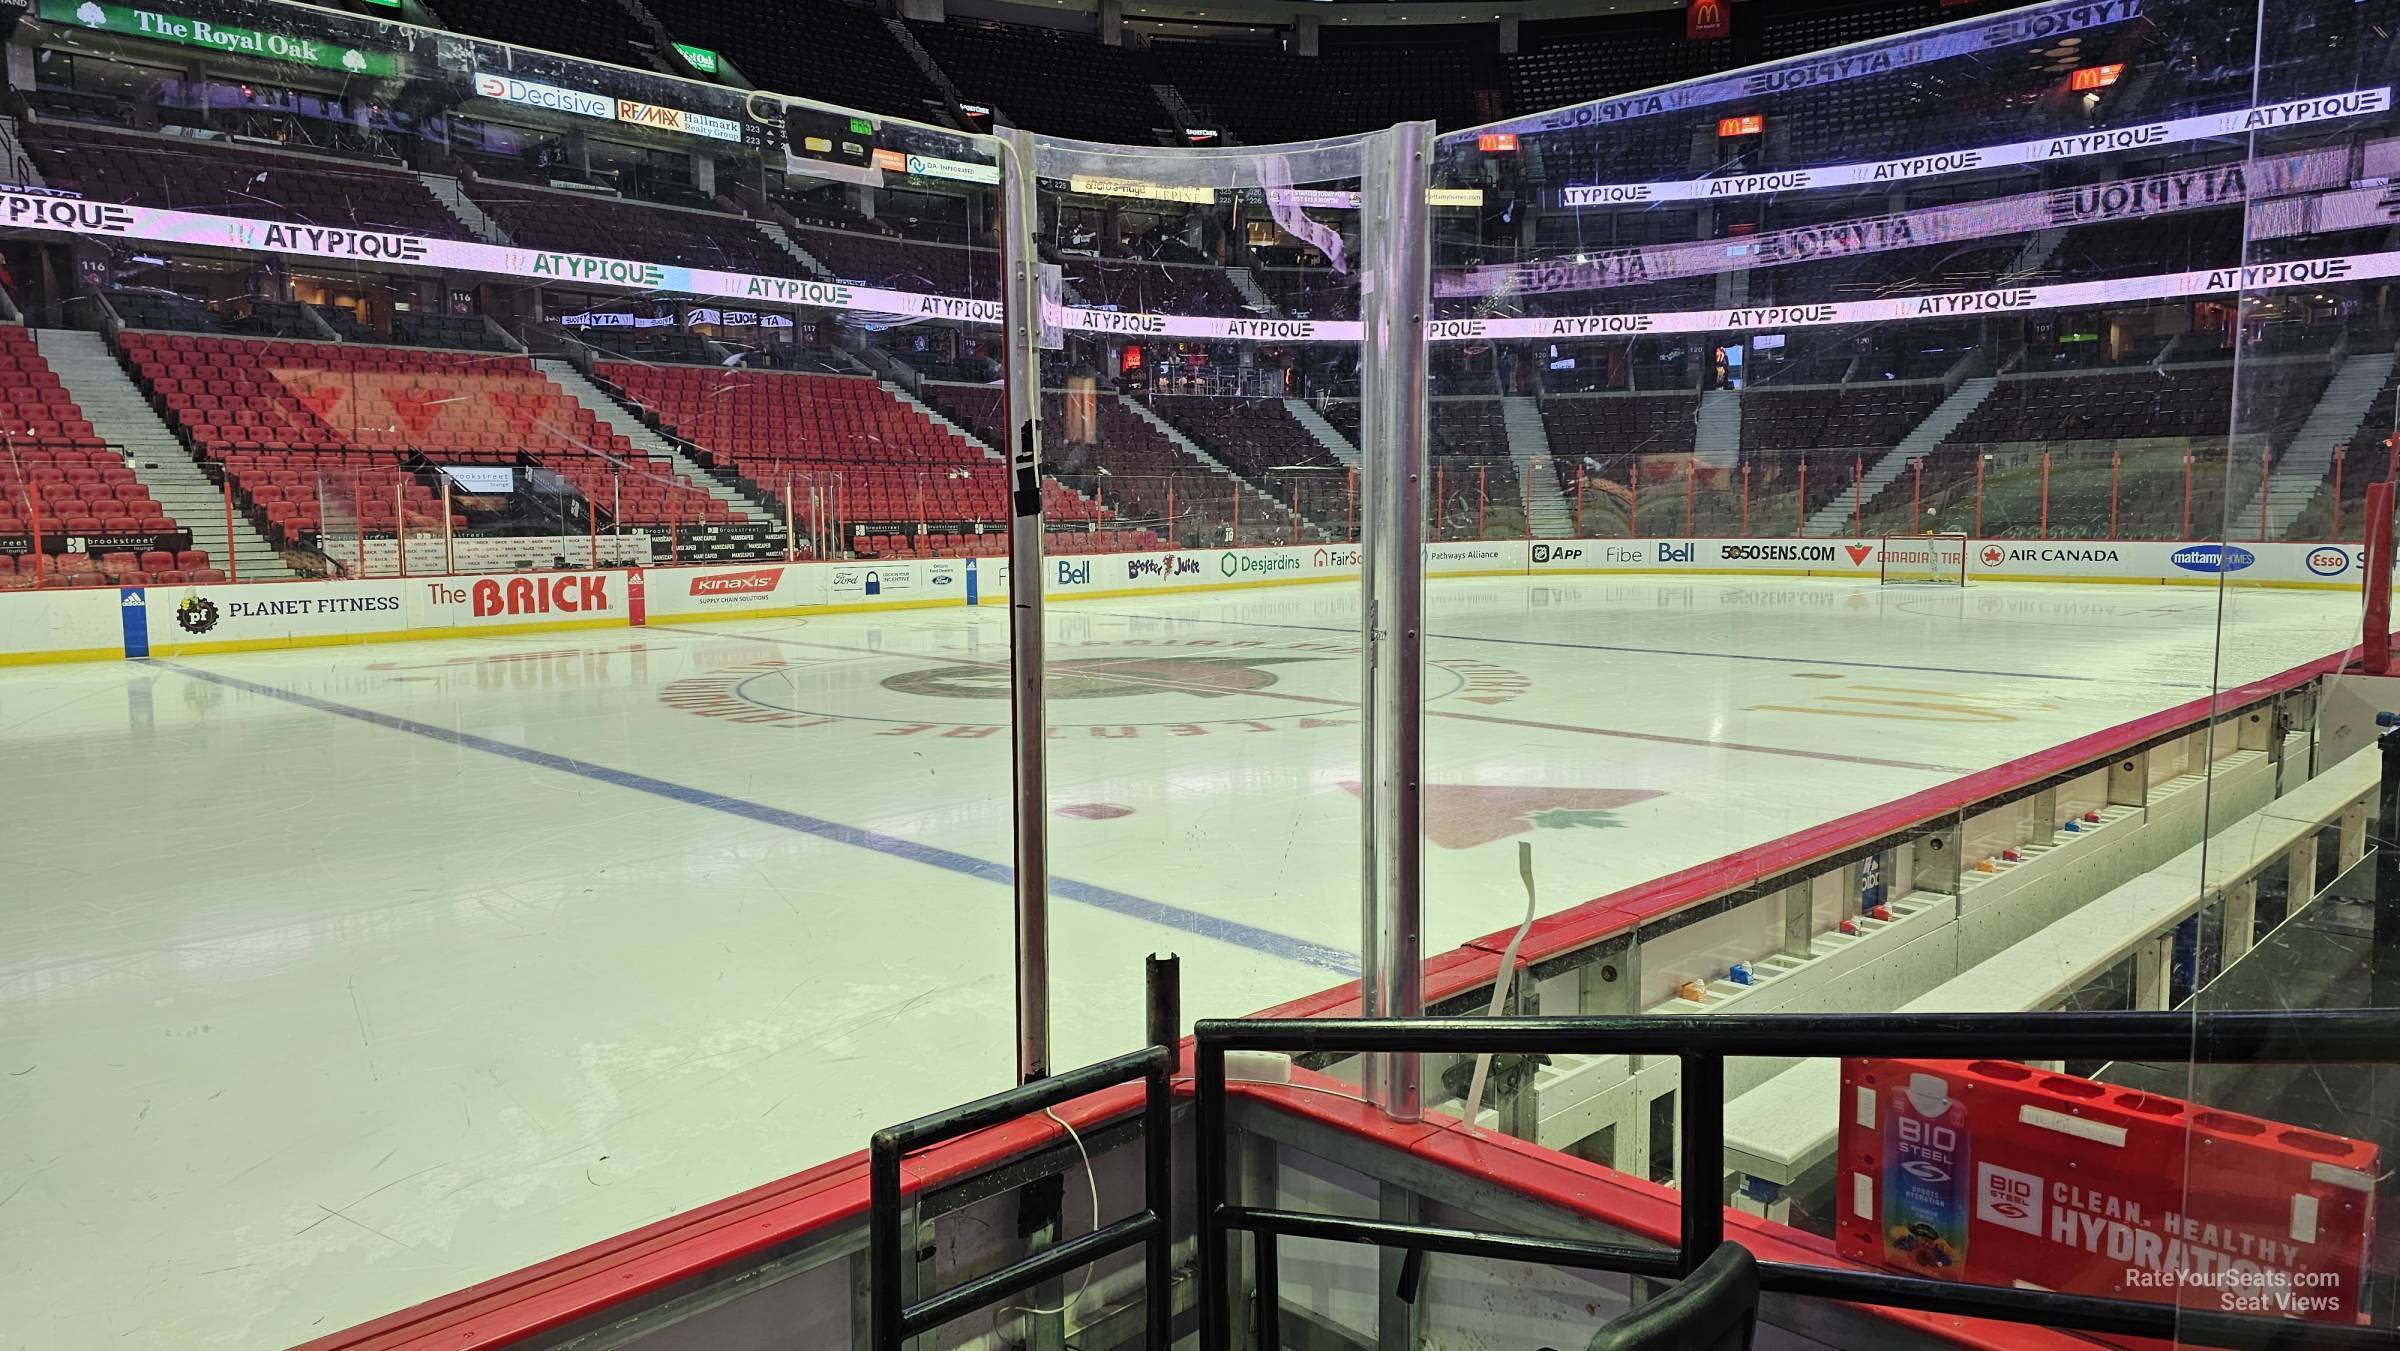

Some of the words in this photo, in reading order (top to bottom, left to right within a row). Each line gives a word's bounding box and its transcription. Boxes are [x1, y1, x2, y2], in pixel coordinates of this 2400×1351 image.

[134, 10, 187, 38] The
[192, 20, 263, 51] Royal
[267, 35, 318, 61] Oak
[509, 80, 606, 116] Decisive
[620, 101, 680, 128] RE/MAX
[2244, 92, 2382, 129] ATYPIQUE
[683, 112, 738, 133] Hallmark
[684, 123, 711, 137] Realty
[714, 127, 740, 141] Group
[745, 124, 760, 133] 323
[745, 136, 760, 145] 223
[2049, 126, 2169, 157] ATYPIQUE
[1874, 152, 1982, 180] ATYPIQUE
[1710, 172, 1811, 196] ATYPIQUE
[264, 224, 427, 261] ATYPIQUE
[81, 261, 105, 271] 116
[533, 253, 664, 285] ATYPIQUE
[2206, 259, 2351, 290] ATYPIQUE
[453, 292, 470, 302] 116
[748, 278, 853, 305] ATYPIQUE
[1918, 289, 2037, 314] ATYPIQUE
[1082, 311, 1165, 333] ATYPIQUE
[1553, 315, 1653, 334] ATYPIQUE
[1728, 305, 1837, 327] ATYPIQUE
[1228, 320, 1314, 337] ATYPIQUE
[88, 536, 154, 545] brookstreet
[720, 526, 759, 534] brookstreet
[711, 543, 735, 551] MANSCAPED
[731, 551, 755, 559] MANSCAPED
[1431, 550, 1466, 561] Pathways
[1468, 549, 1499, 559] Alliance
[1606, 546, 1642, 563] Fibe
[1658, 542, 1694, 563] Bell
[2009, 549, 2036, 562] AIR
[2040, 549, 2119, 563] CANADA
[1241, 555, 1300, 575] Desjardins
[2174, 550, 2222, 567] mattamy
[2224, 552, 2253, 565] HOMES
[2313, 554, 2343, 567] Esso
[833, 572, 859, 586] Ford
[1058, 560, 1090, 585] Bell
[229, 600, 312, 618] PLANET
[317, 596, 400, 614] FITNESS
[427, 583, 466, 605] The
[472, 576, 607, 617] BRICK
[189, 608, 207, 625] pf
[1898, 1116, 1956, 1152] BIO
[1899, 1142, 1953, 1165] STEEL
[1990, 1173, 2030, 1198] BIO
[1905, 1191, 1944, 1208] HYDRATION
[1990, 1190, 2030, 1207] STEEL
[2053, 1182, 2150, 1227] CLEAN.
[2164, 1211, 2308, 1271] HEALTHY.
